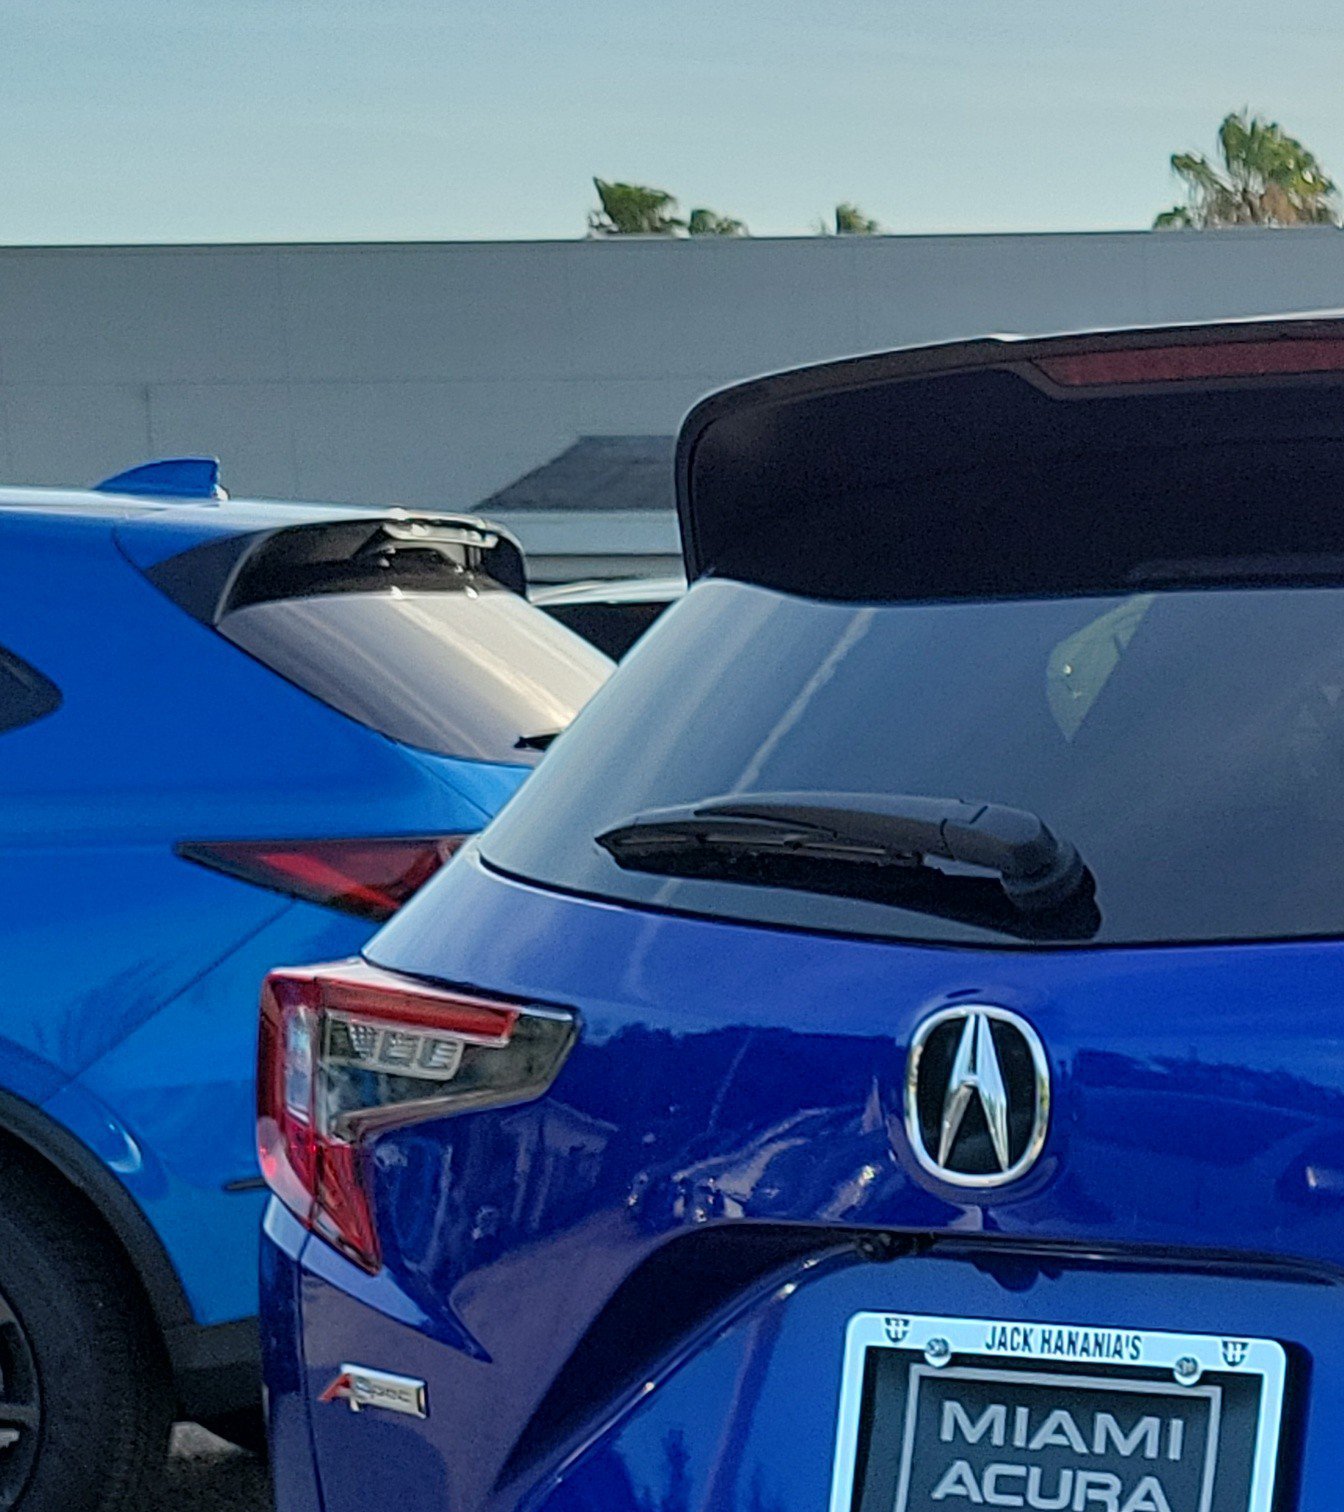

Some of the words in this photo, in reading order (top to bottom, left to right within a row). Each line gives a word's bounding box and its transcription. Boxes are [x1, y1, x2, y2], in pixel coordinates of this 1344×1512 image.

[985, 1326, 1033, 1353] JACK
[1040, 1329, 1143, 1361] HANANIA'S
[940, 1400, 1184, 1461] MIAMI
